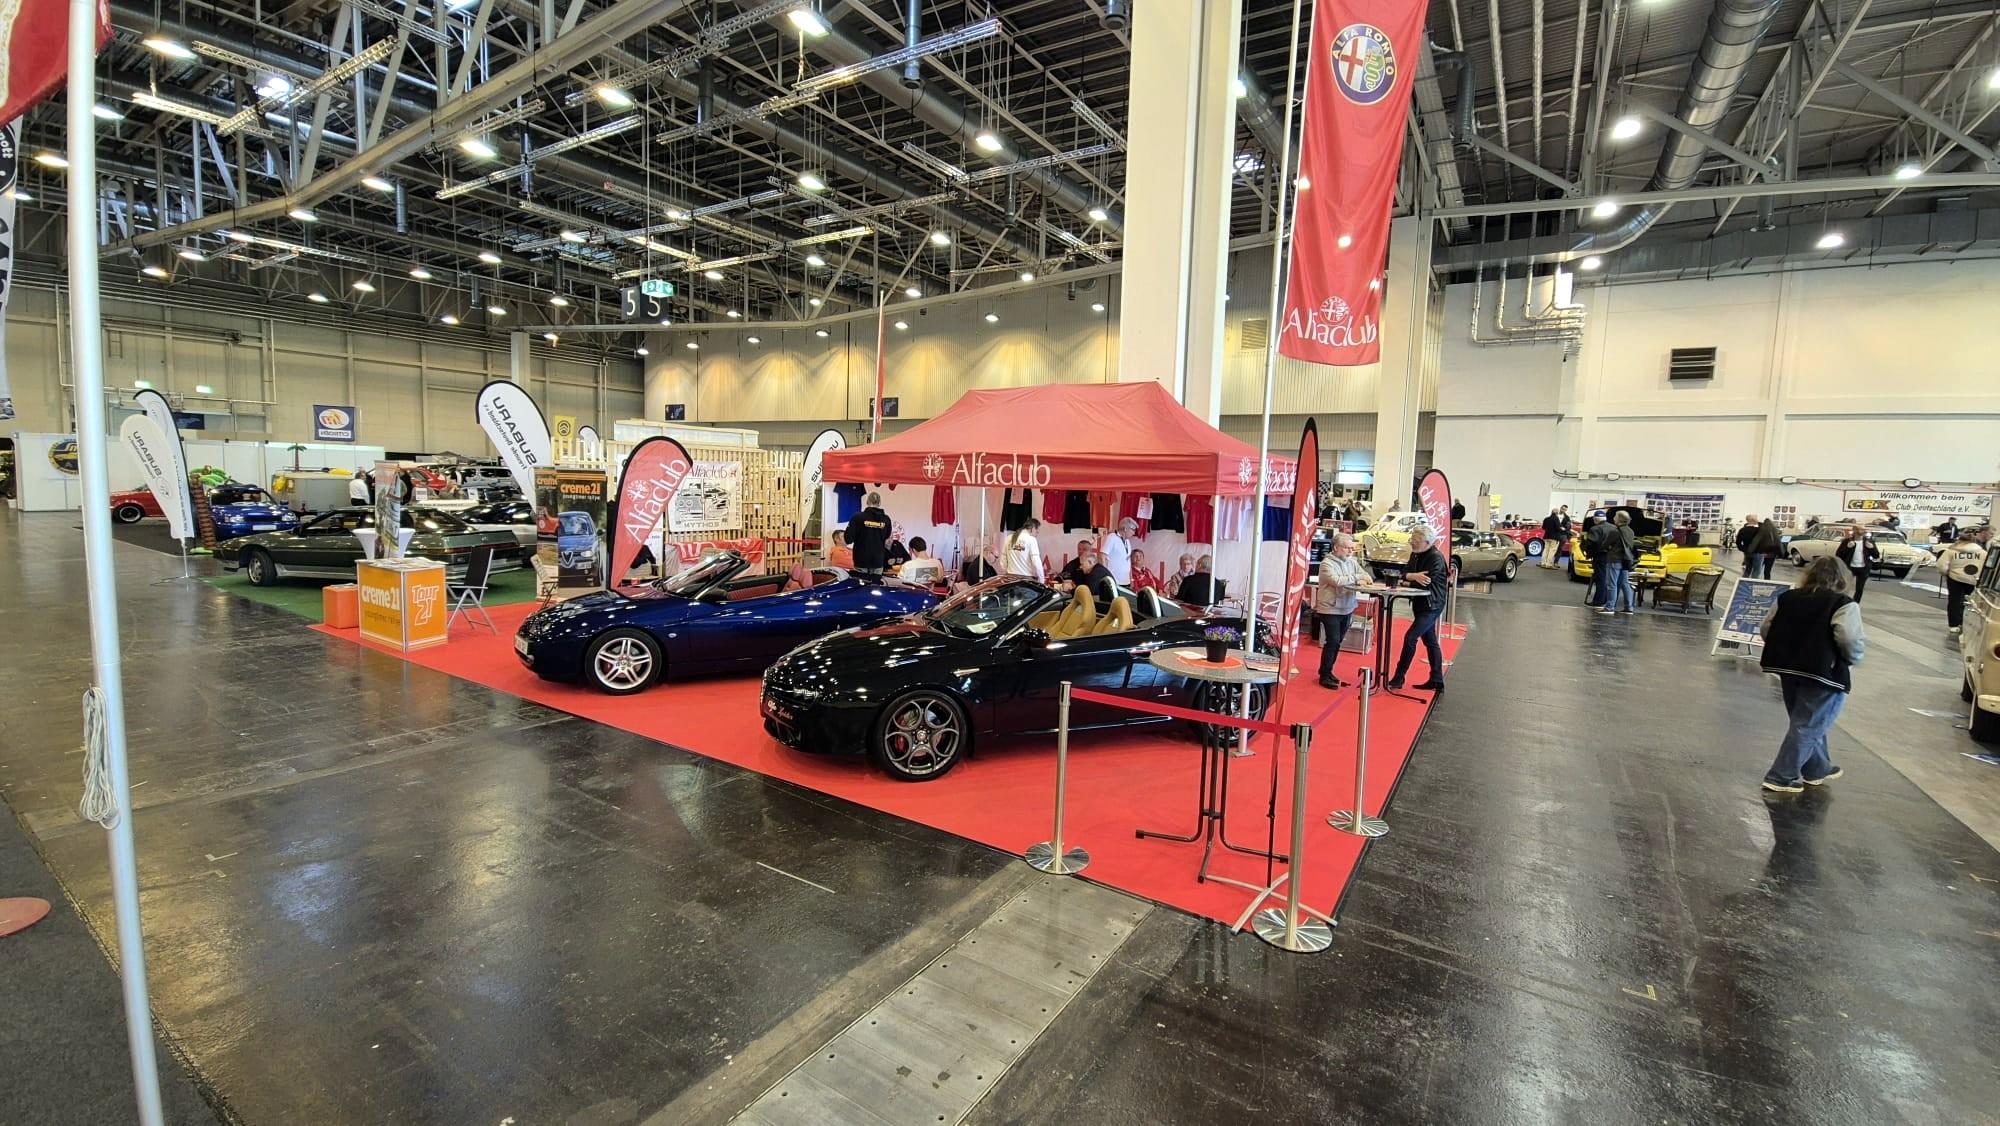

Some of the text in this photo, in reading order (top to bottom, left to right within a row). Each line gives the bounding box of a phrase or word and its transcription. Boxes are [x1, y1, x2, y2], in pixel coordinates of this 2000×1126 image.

[1332, 27, 1395, 75] ALFA ROMEO
[626, 289, 636, 316] 5
[647, 295, 661, 316] 5
[951, 451, 1051, 487] Alfaclub
[624, 459, 686, 544] Alfaclub
[1879, 492, 1937, 501] Willkommen
[1895, 503, 1912, 511] Club
[1913, 504, 1957, 512] Deutschland
[1953, 552, 1981, 560] ICON
[412, 584, 439, 603] Tour
[414, 599, 433, 626] 21
